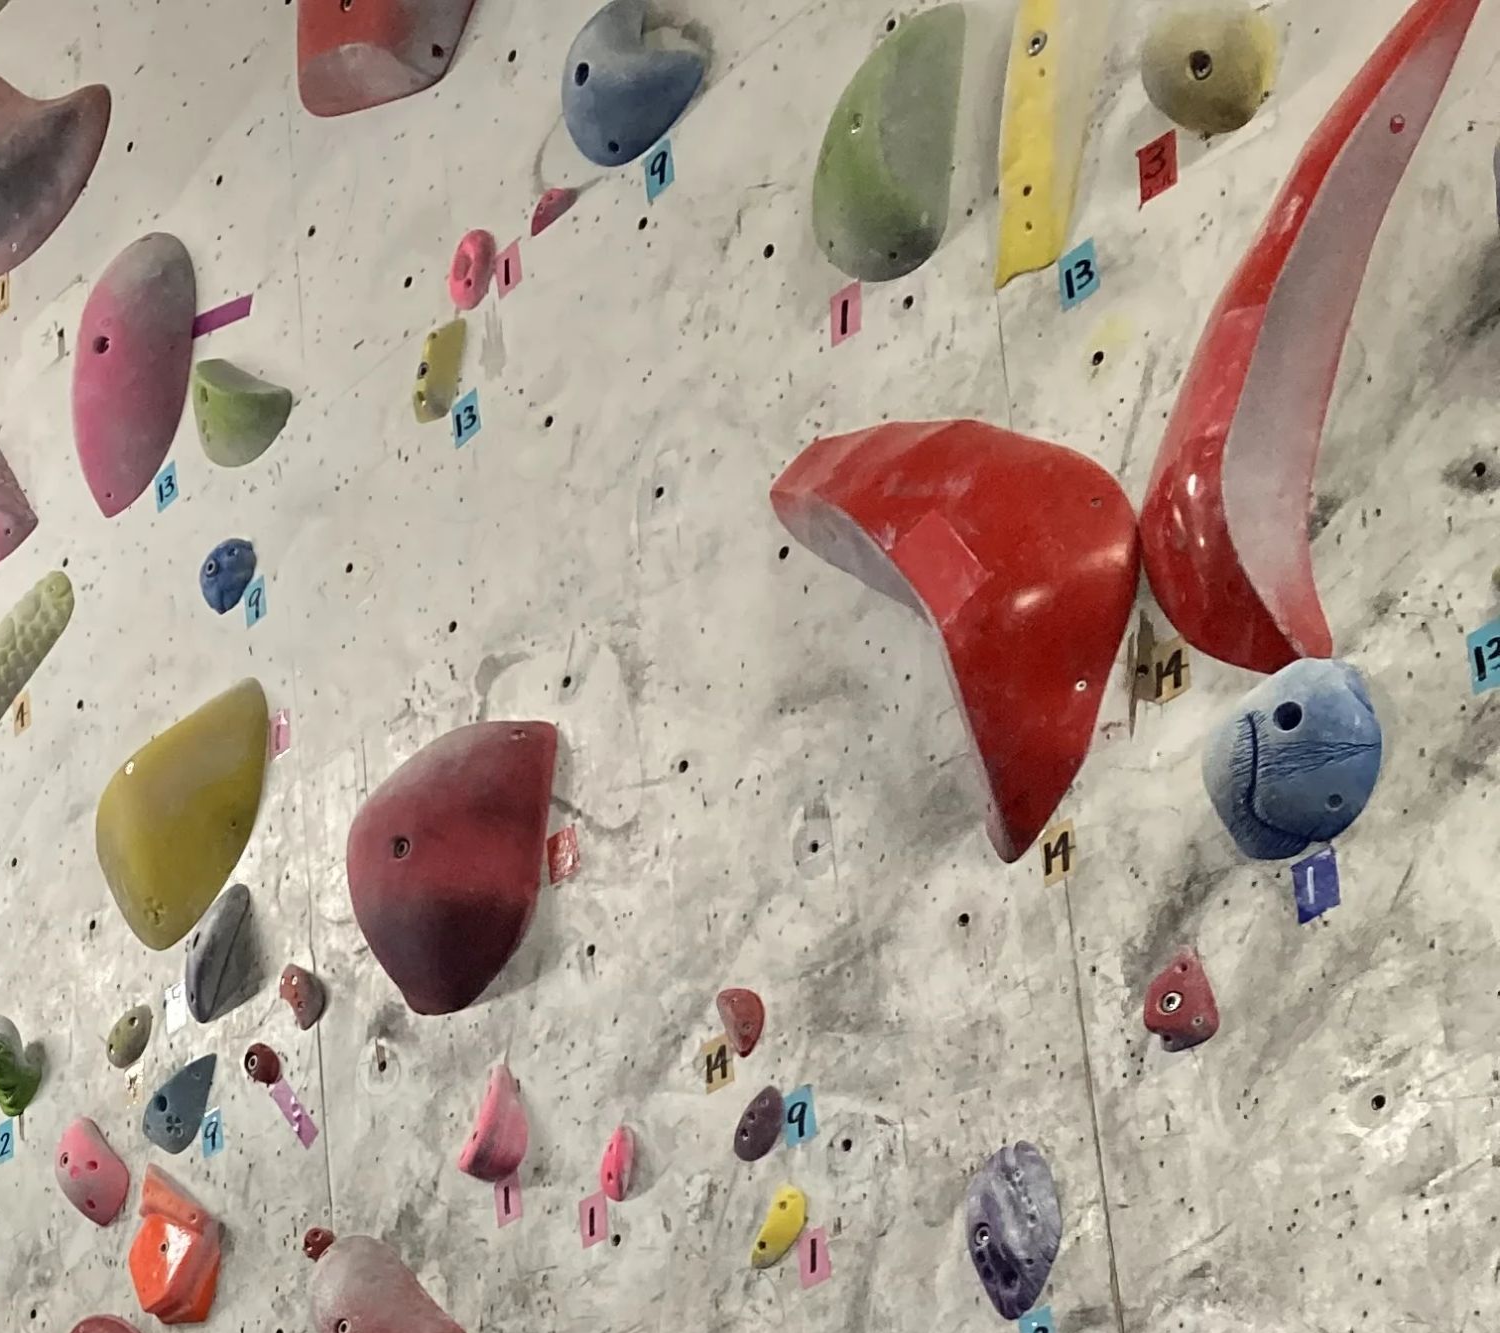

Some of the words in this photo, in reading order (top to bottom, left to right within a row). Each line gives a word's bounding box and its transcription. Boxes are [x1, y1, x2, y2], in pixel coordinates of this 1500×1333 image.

[650, 151, 668, 185] 9
[1143, 145, 1166, 180] 3
[1065, 258, 1094, 299] 13
[840, 299, 848, 335] 1
[455, 405, 477, 437] 13
[158, 474, 175, 503] 13
[249, 587, 261, 619] 9
[1155, 648, 1190, 698] 14
[1044, 830, 1076, 873] 14
[705, 1044, 731, 1084] 14
[204, 1121, 218, 1151] 9
[787, 1101, 807, 1137] 9
[0, 1132, 10, 1157] 2
[810, 1238, 817, 1273] 1
